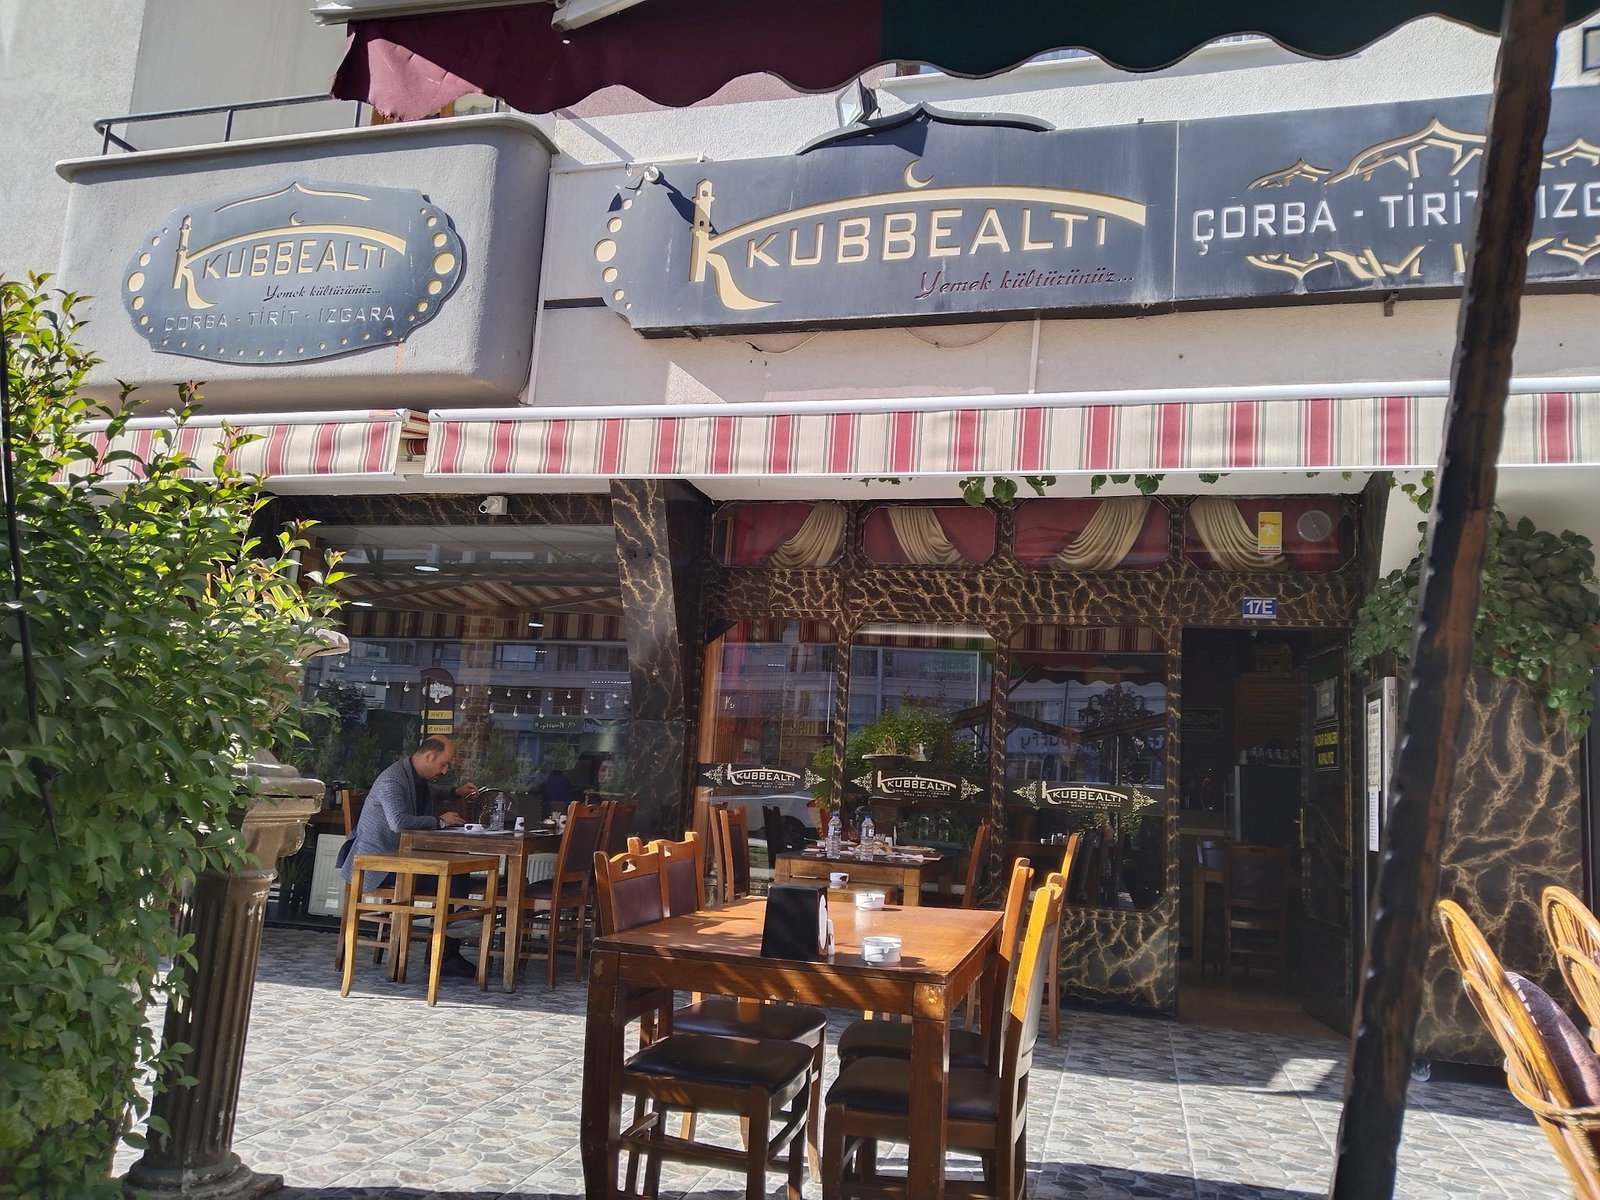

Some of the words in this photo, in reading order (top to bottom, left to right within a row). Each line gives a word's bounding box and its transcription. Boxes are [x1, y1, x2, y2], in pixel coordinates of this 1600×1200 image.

[746, 208, 1106, 268] KUBBEALTI
[1191, 201, 1337, 256] ÇORBA
[202, 238, 387, 280] KUBBEALTI
[262, 284, 306, 302] Yemek
[913, 269, 992, 301] Yemek
[248, 304, 299, 326] TİRİT
[318, 305, 396, 324] IZGARA
[1246, 599, 1273, 615] 17E
[736, 771, 796, 782] KUBBEALTI
[887, 780, 951, 792] KUBBEALTI
[1053, 790, 1122, 803] KUBBEALTI
